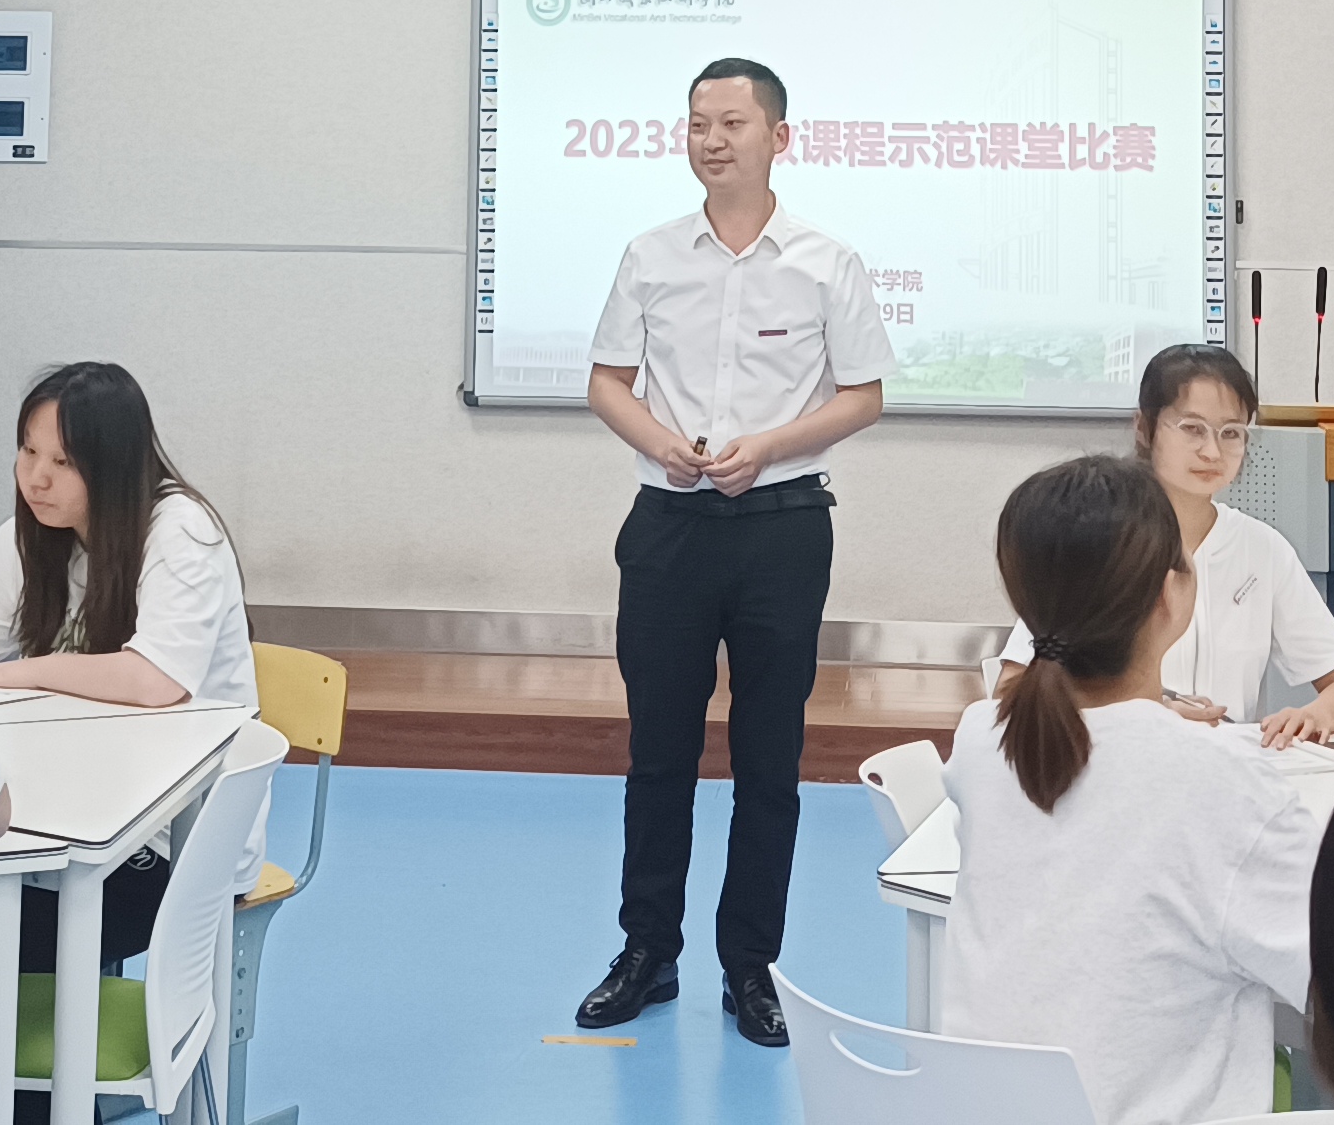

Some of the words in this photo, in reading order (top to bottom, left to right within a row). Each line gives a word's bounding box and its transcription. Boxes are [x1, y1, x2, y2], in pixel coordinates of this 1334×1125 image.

[604, 13, 647, 22] Vocational
[649, 13, 666, 22] And
[669, 13, 707, 23] Technical
[710, 14, 742, 25] College
[878, 302, 914, 325] 9日
